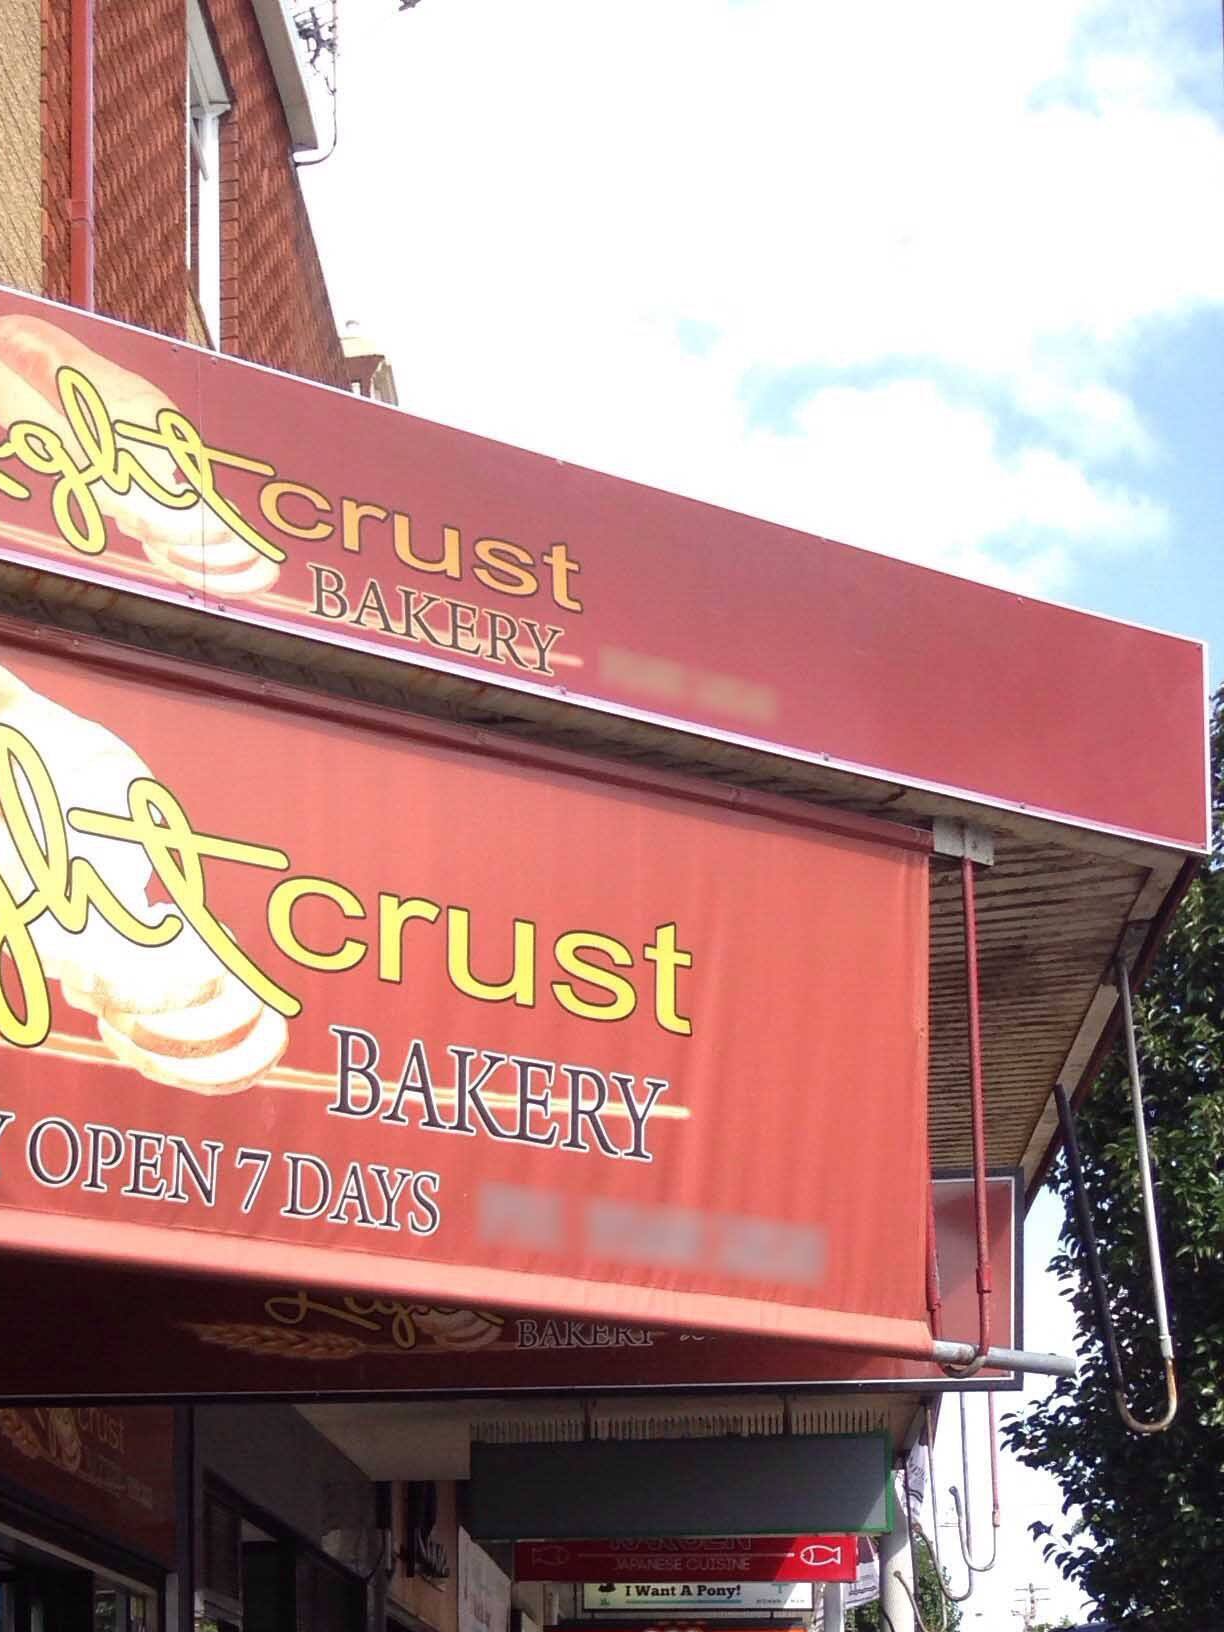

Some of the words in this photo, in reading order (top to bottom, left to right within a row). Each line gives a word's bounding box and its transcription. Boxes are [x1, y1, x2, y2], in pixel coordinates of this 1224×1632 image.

[259, 480, 584, 612] crust
[309, 564, 564, 677] BAKERY
[266, 874, 694, 1035] crust
[328, 1025, 669, 1163] BAKERY
[28, 1118, 223, 1206] OPEN
[234, 1148, 270, 1213] 7
[283, 1154, 440, 1234] DAYS
[612, 1558, 683, 1571] JAPANESE
[686, 1557, 752, 1571] CUISINE
[625, 1585, 631, 1596] I
[635, 1585, 676, 1597] Want
[680, 1585, 694, 1597] A
[697, 1585, 742, 1599] Pony!
